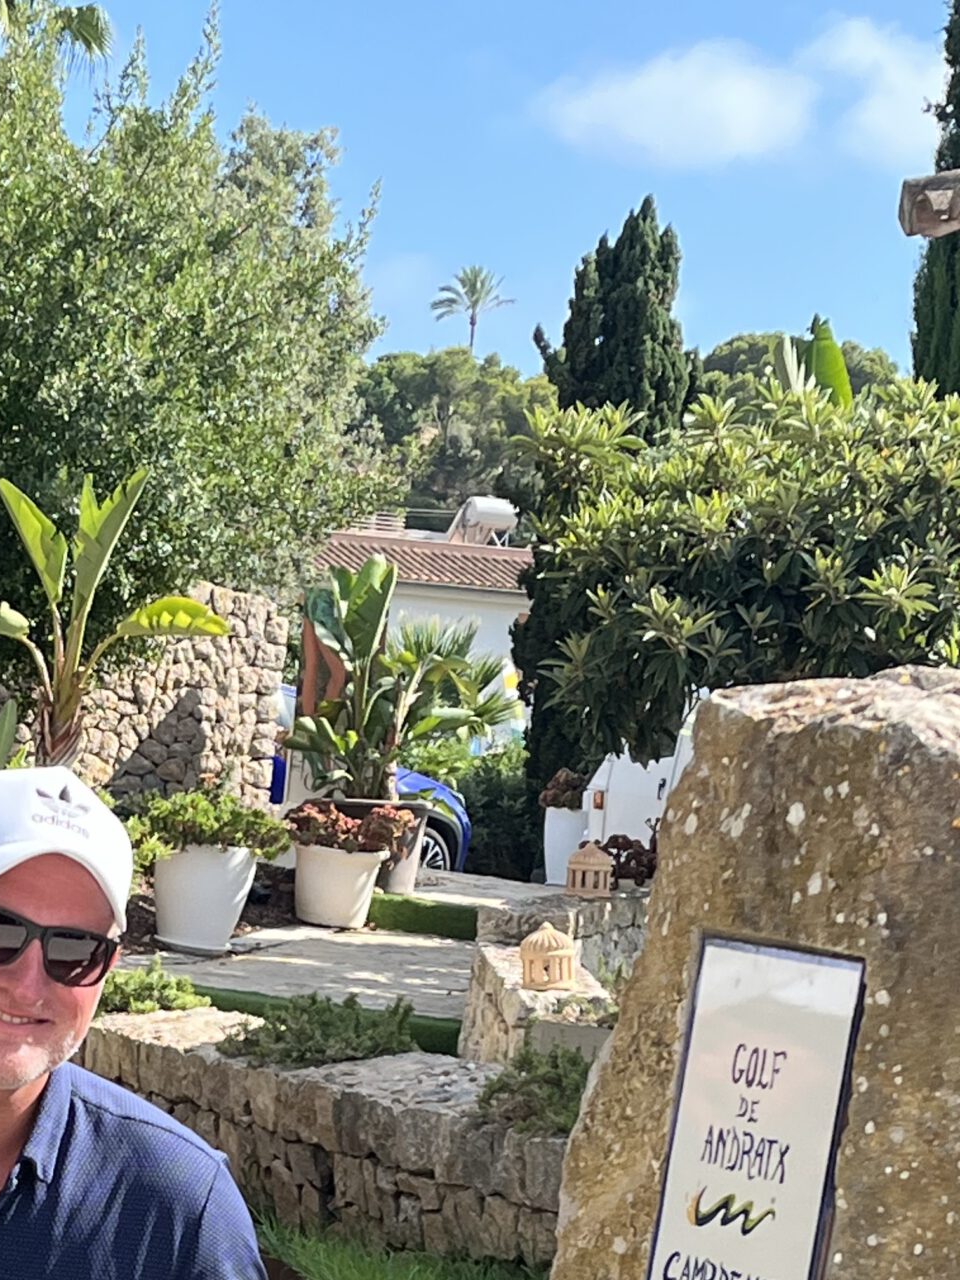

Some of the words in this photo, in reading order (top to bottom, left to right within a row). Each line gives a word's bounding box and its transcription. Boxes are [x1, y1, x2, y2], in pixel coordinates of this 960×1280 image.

[31, 813, 89, 839] adidas
[731, 1043, 787, 1090] GOLF
[737, 1096, 759, 1123] DE
[700, 1125, 790, 1184] ANDRATX
